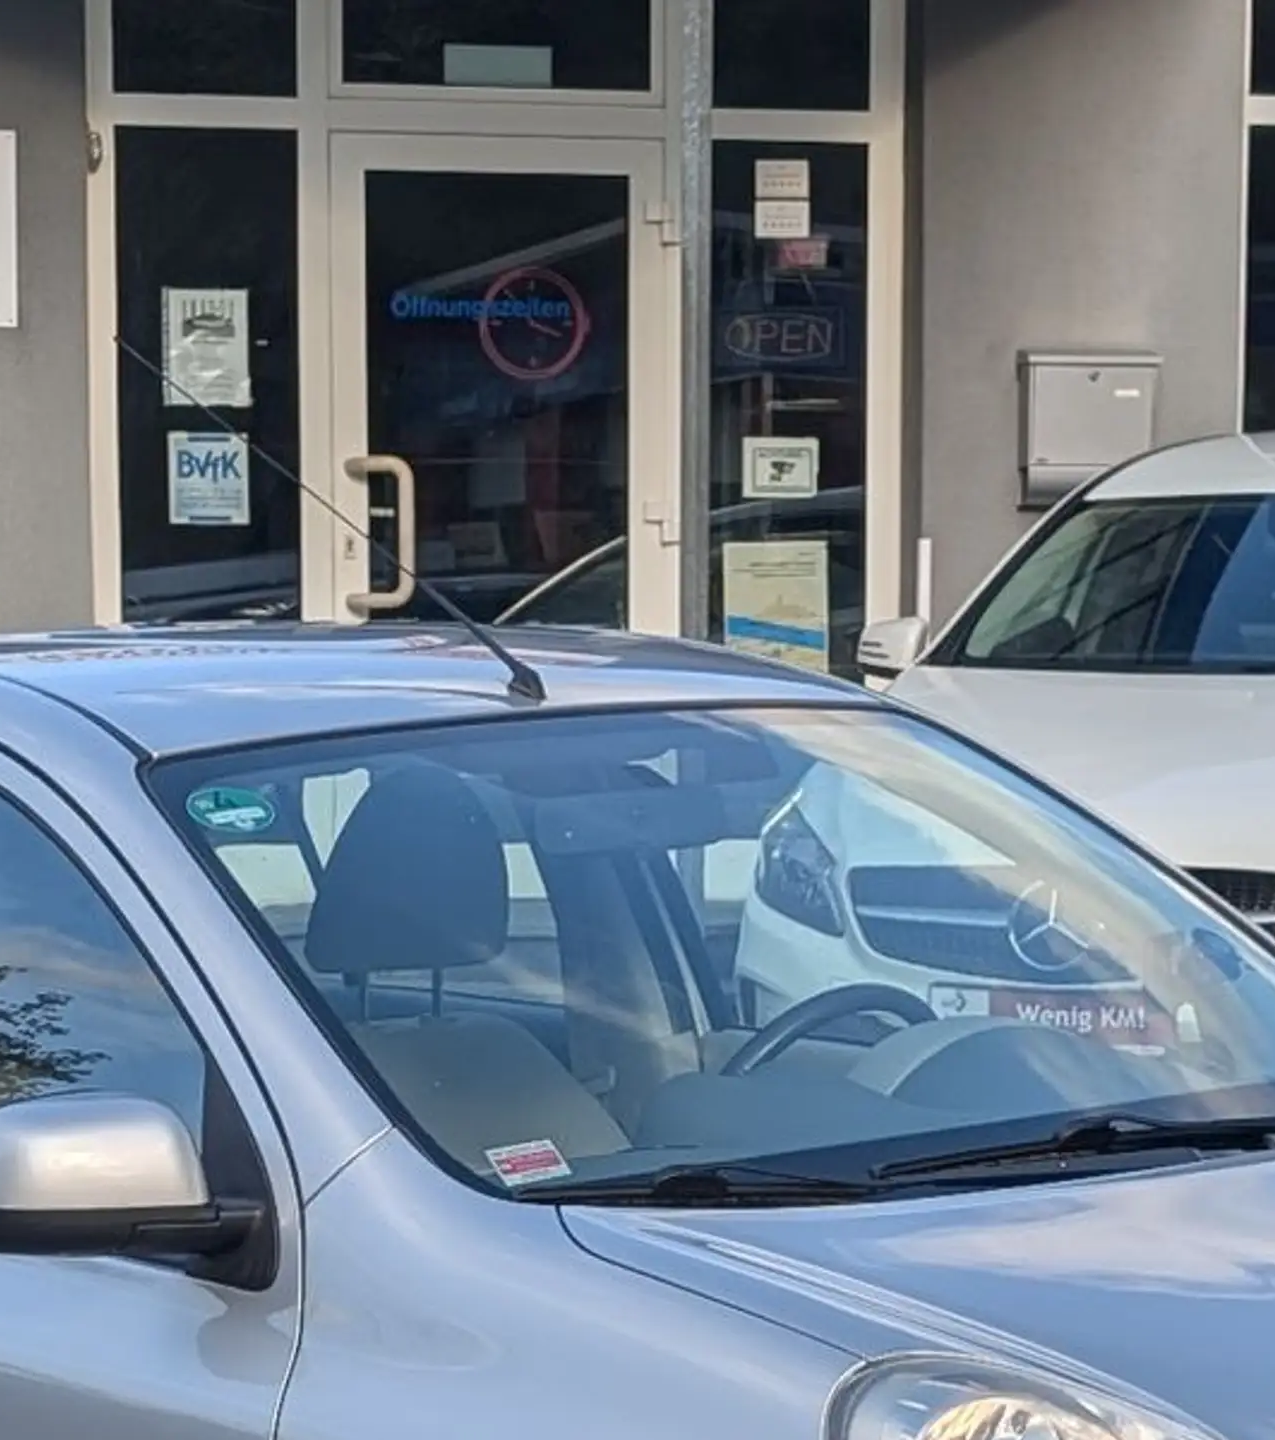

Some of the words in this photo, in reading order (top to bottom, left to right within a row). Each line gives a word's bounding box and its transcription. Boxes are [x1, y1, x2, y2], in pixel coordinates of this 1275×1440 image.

[727, 317, 834, 354] OPEN
[1016, 1003, 1093, 1033] Wenig
[1100, 1006, 1146, 1030] KM!
